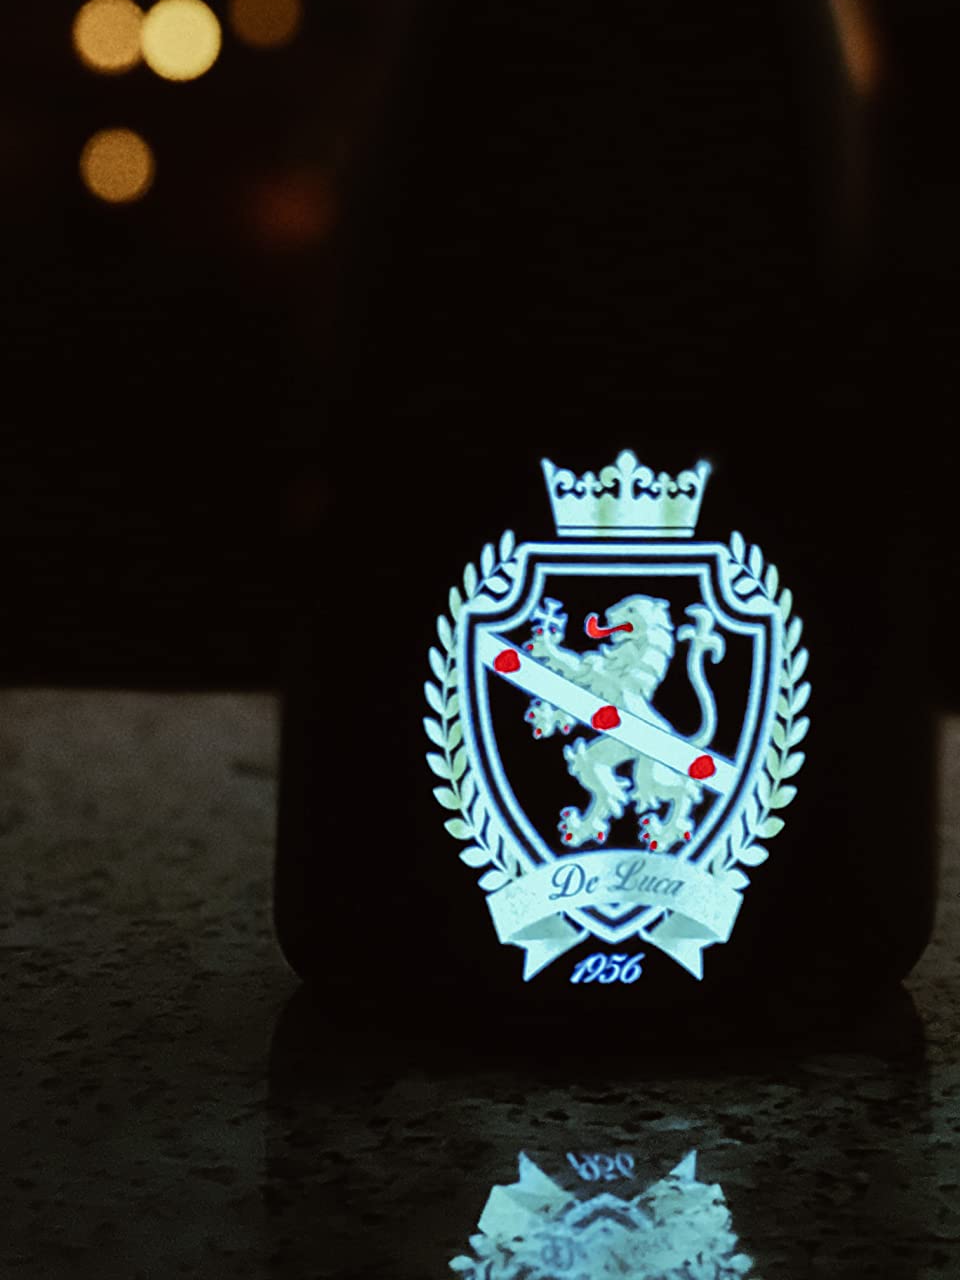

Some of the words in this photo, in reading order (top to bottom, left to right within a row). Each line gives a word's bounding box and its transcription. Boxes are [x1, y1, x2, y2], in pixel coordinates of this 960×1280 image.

[549, 863, 599, 900] De
[606, 859, 686, 896] Luca
[570, 952, 645, 984] 1956
